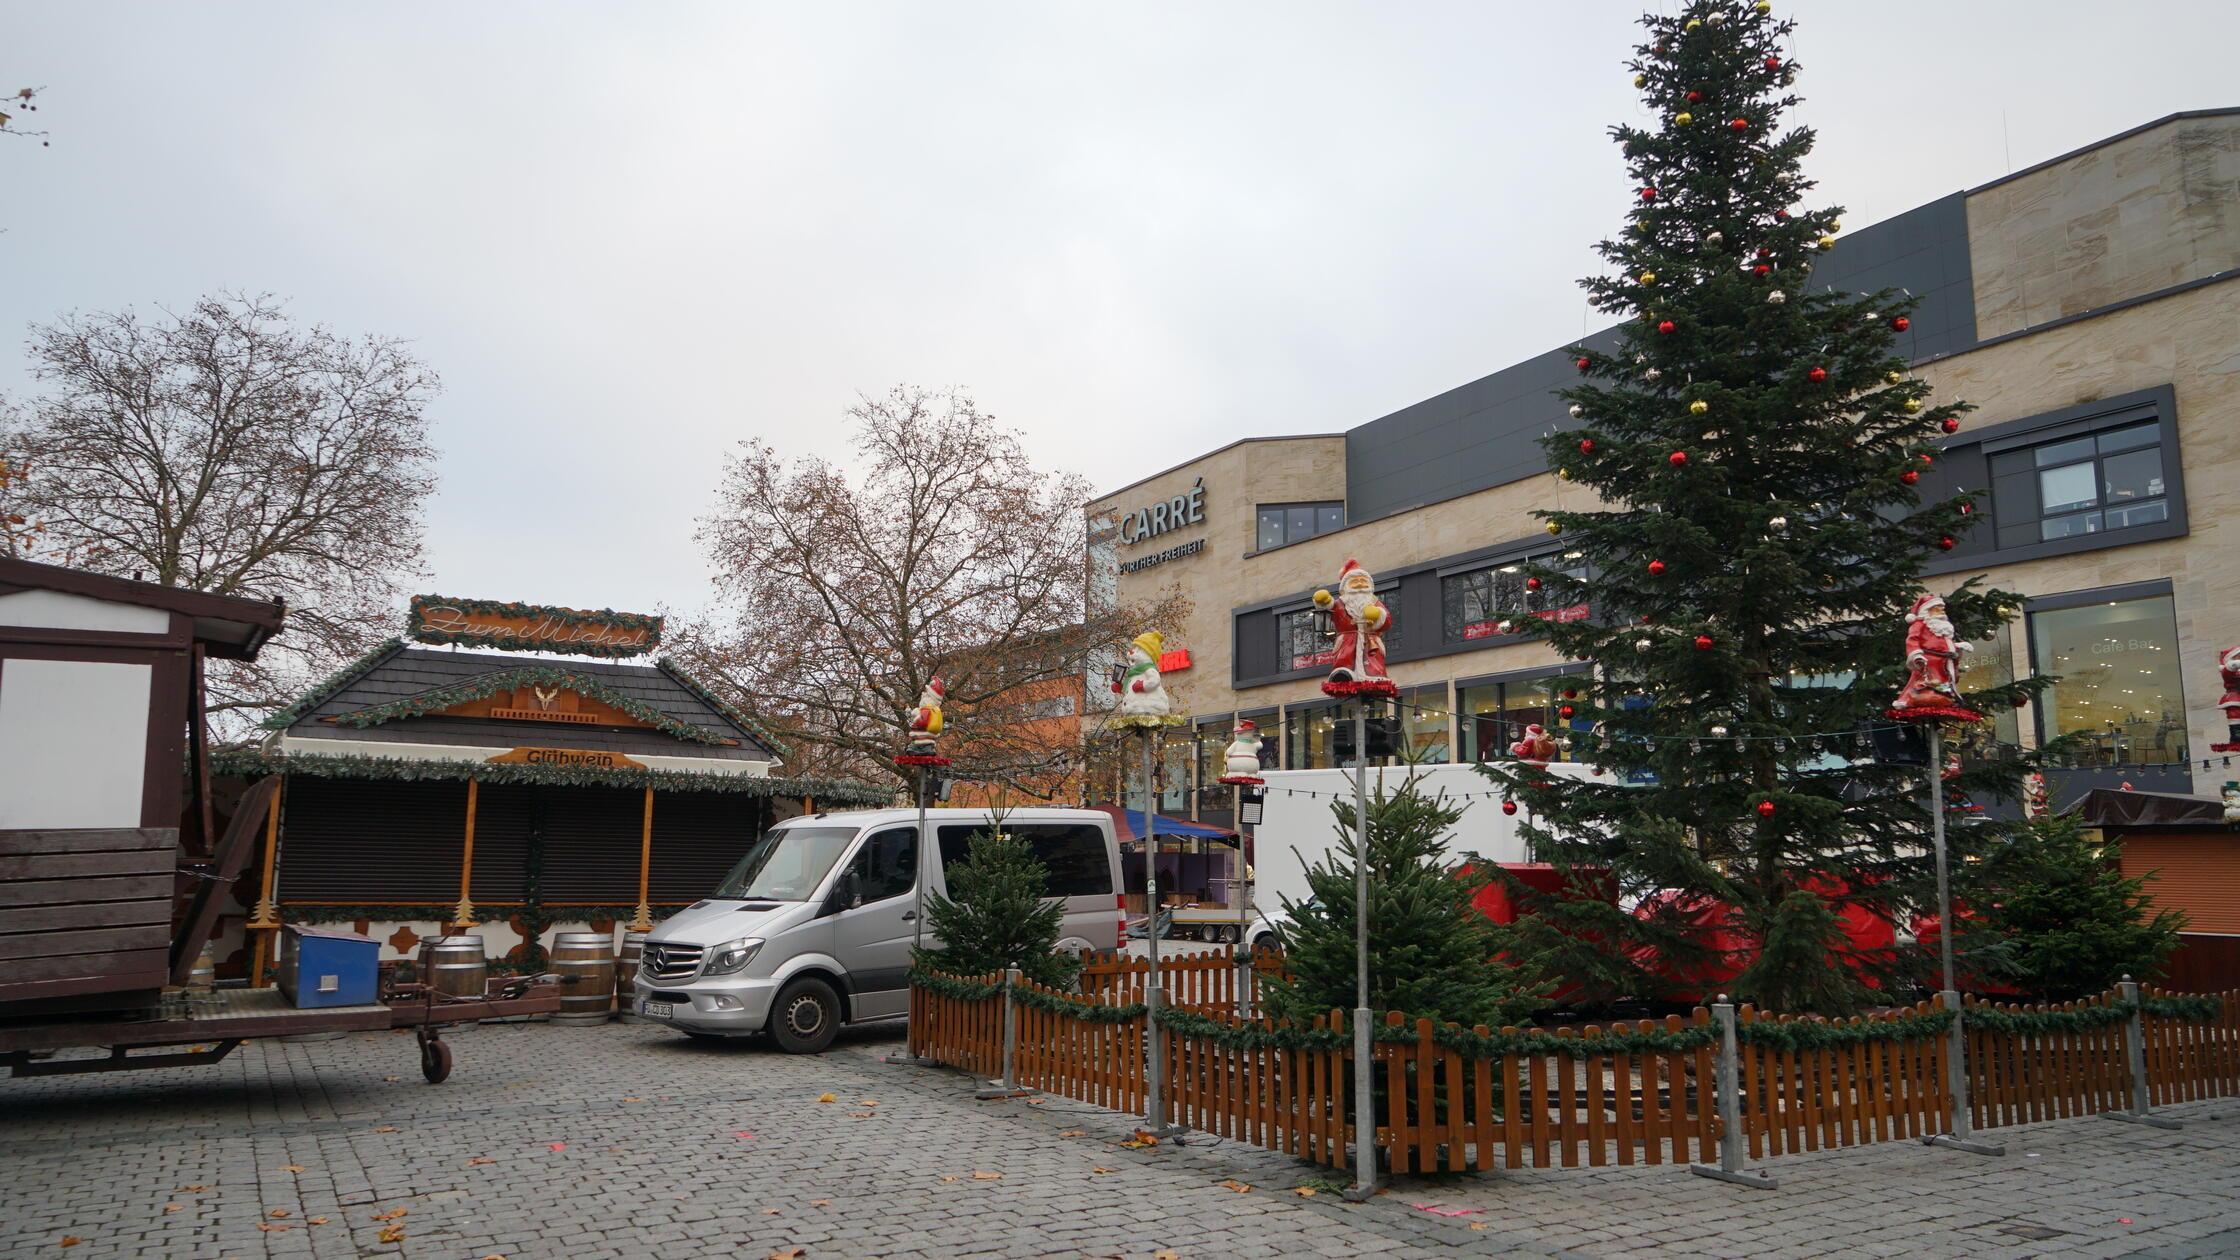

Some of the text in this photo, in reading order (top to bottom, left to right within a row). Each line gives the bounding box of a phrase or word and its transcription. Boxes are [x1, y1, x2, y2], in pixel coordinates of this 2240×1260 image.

[1119, 477, 1206, 545] CARRÉ
[1160, 538, 1206, 563] FREIHEIT
[420, 606, 646, 647] Zum Michel
[527, 750, 613, 767] Glühwein
